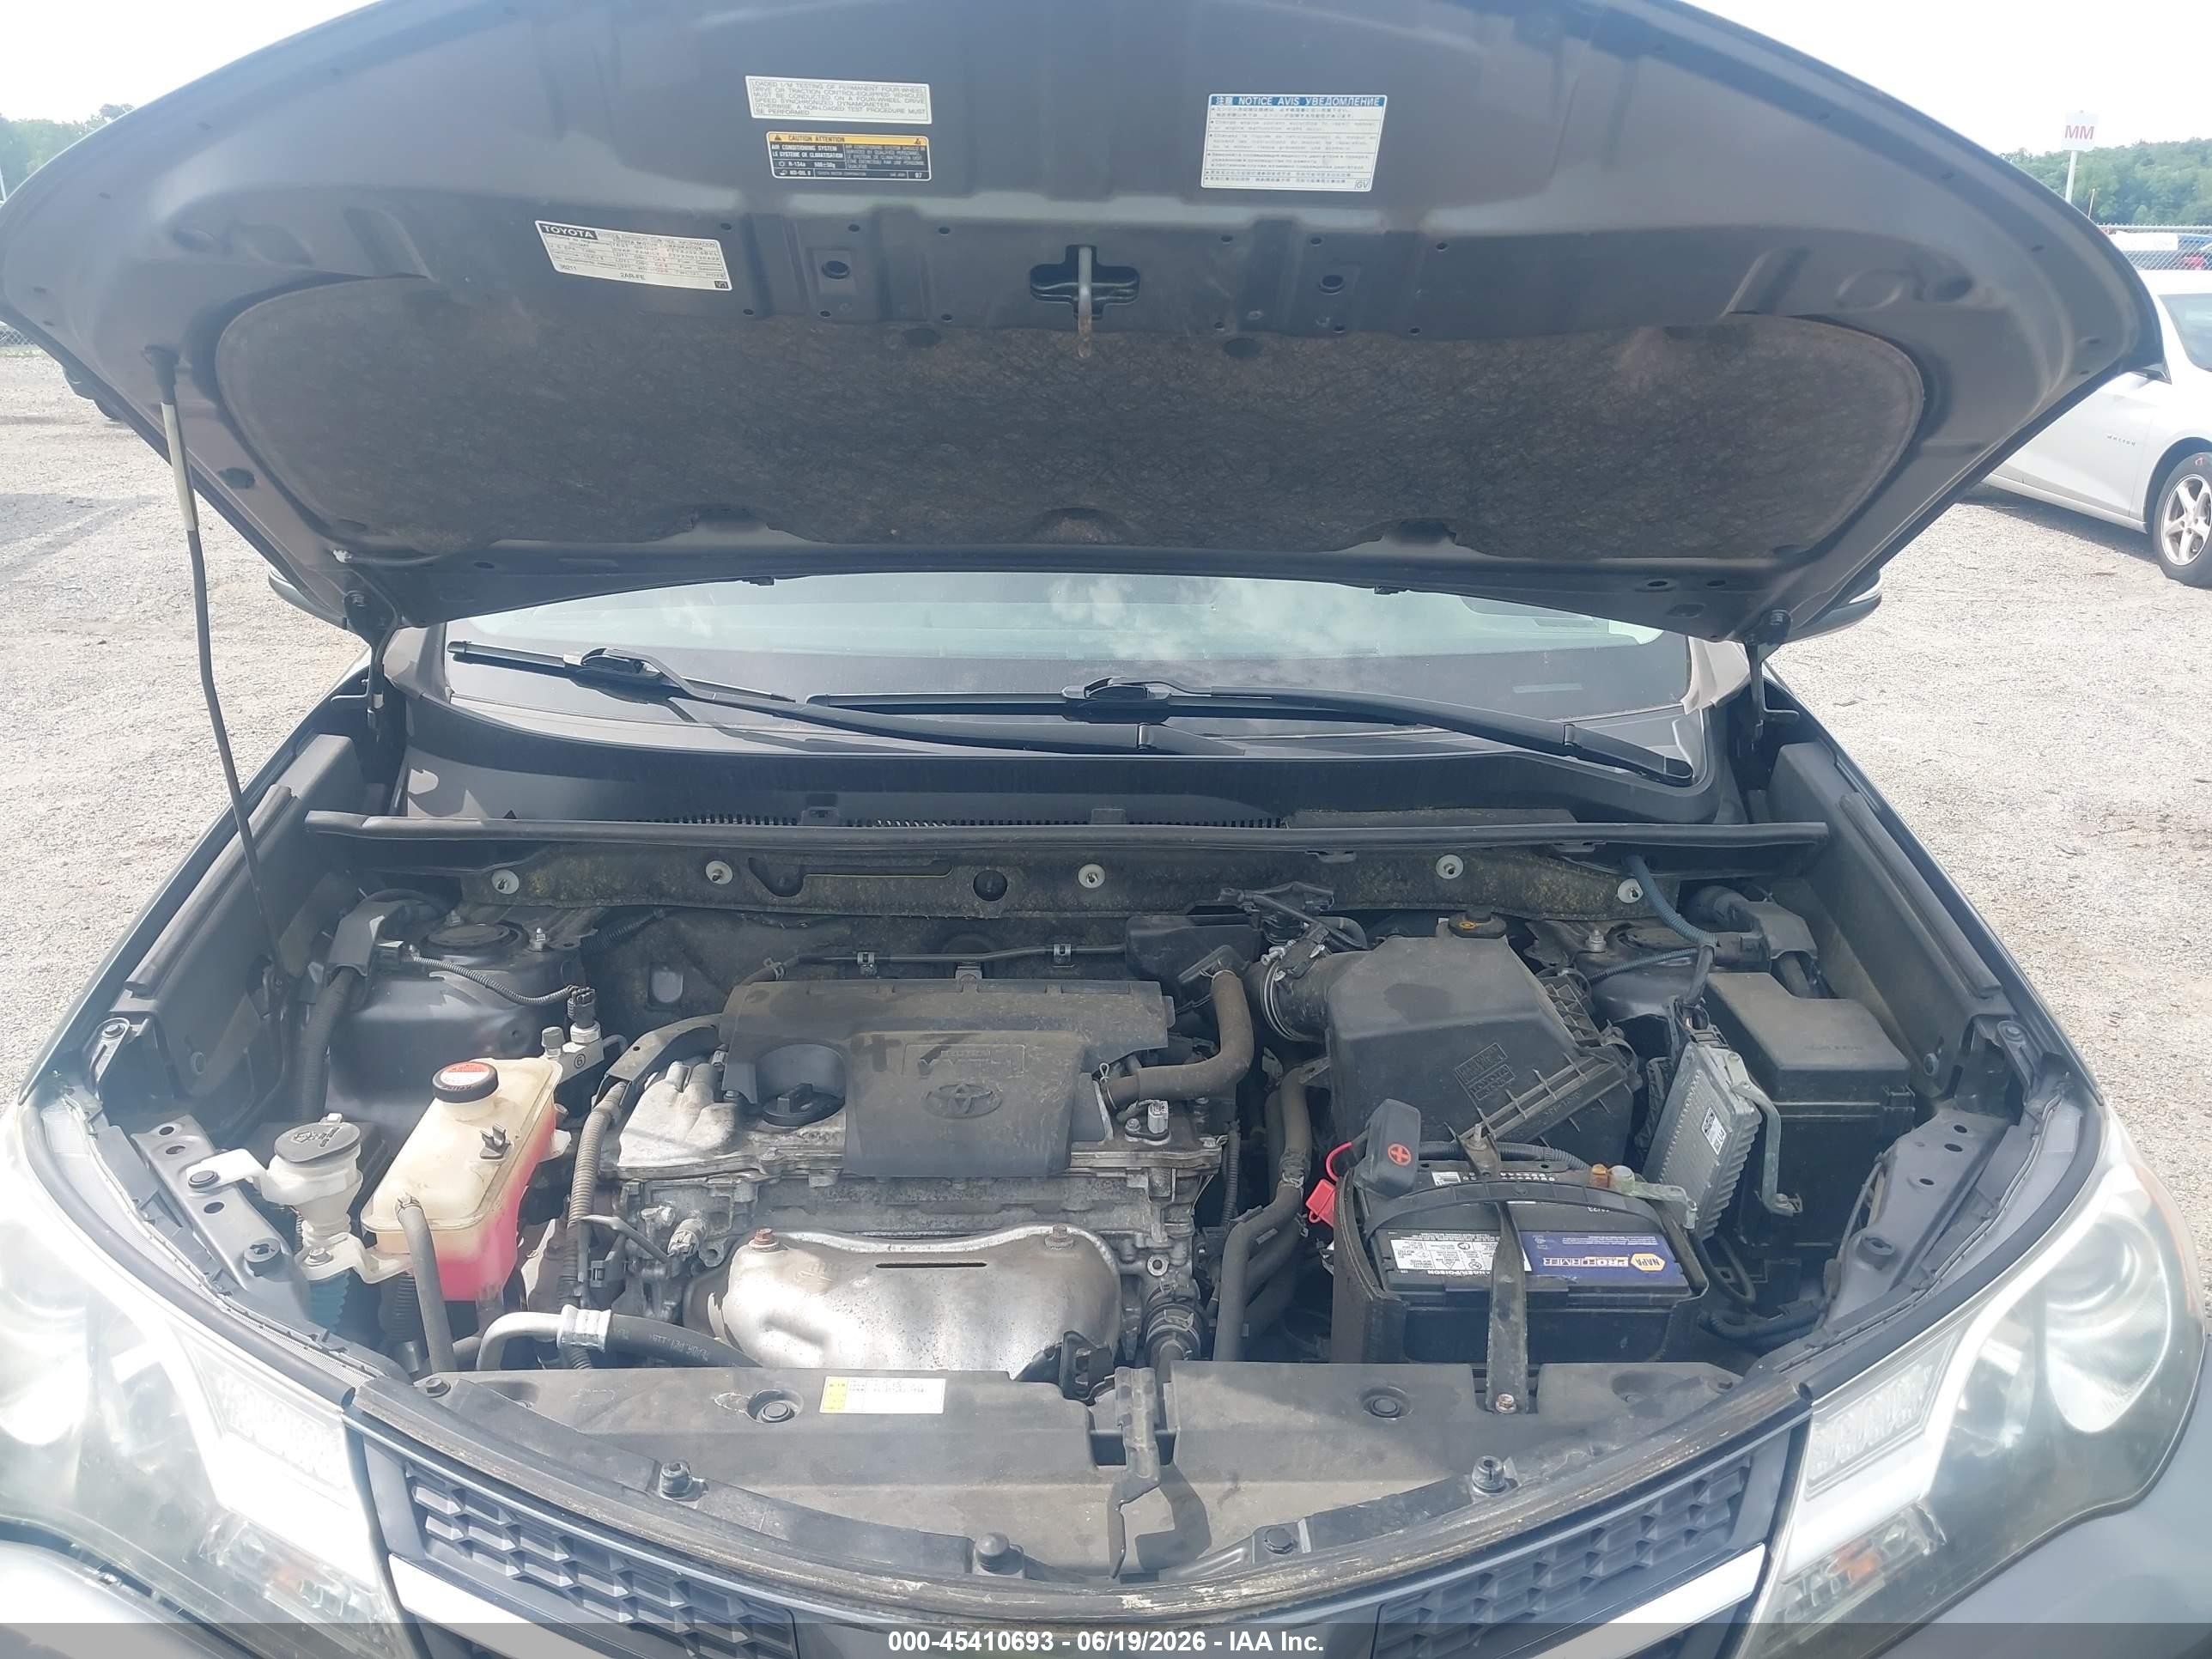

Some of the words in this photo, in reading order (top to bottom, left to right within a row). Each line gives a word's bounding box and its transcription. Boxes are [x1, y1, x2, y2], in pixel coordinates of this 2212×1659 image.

[1238, 97, 1273, 105] NOTICE
[1278, 97, 1300, 105] AVIS
[1305, 97, 1380, 106] УВЕДОМЛЕНИЕ
[2064, 125, 2095, 140] MM
[542, 225, 594, 238] TOYOTA
[1544, 1257, 1629, 1267] PROFORMER
[1635, 1258, 1659, 1267] NAPA
